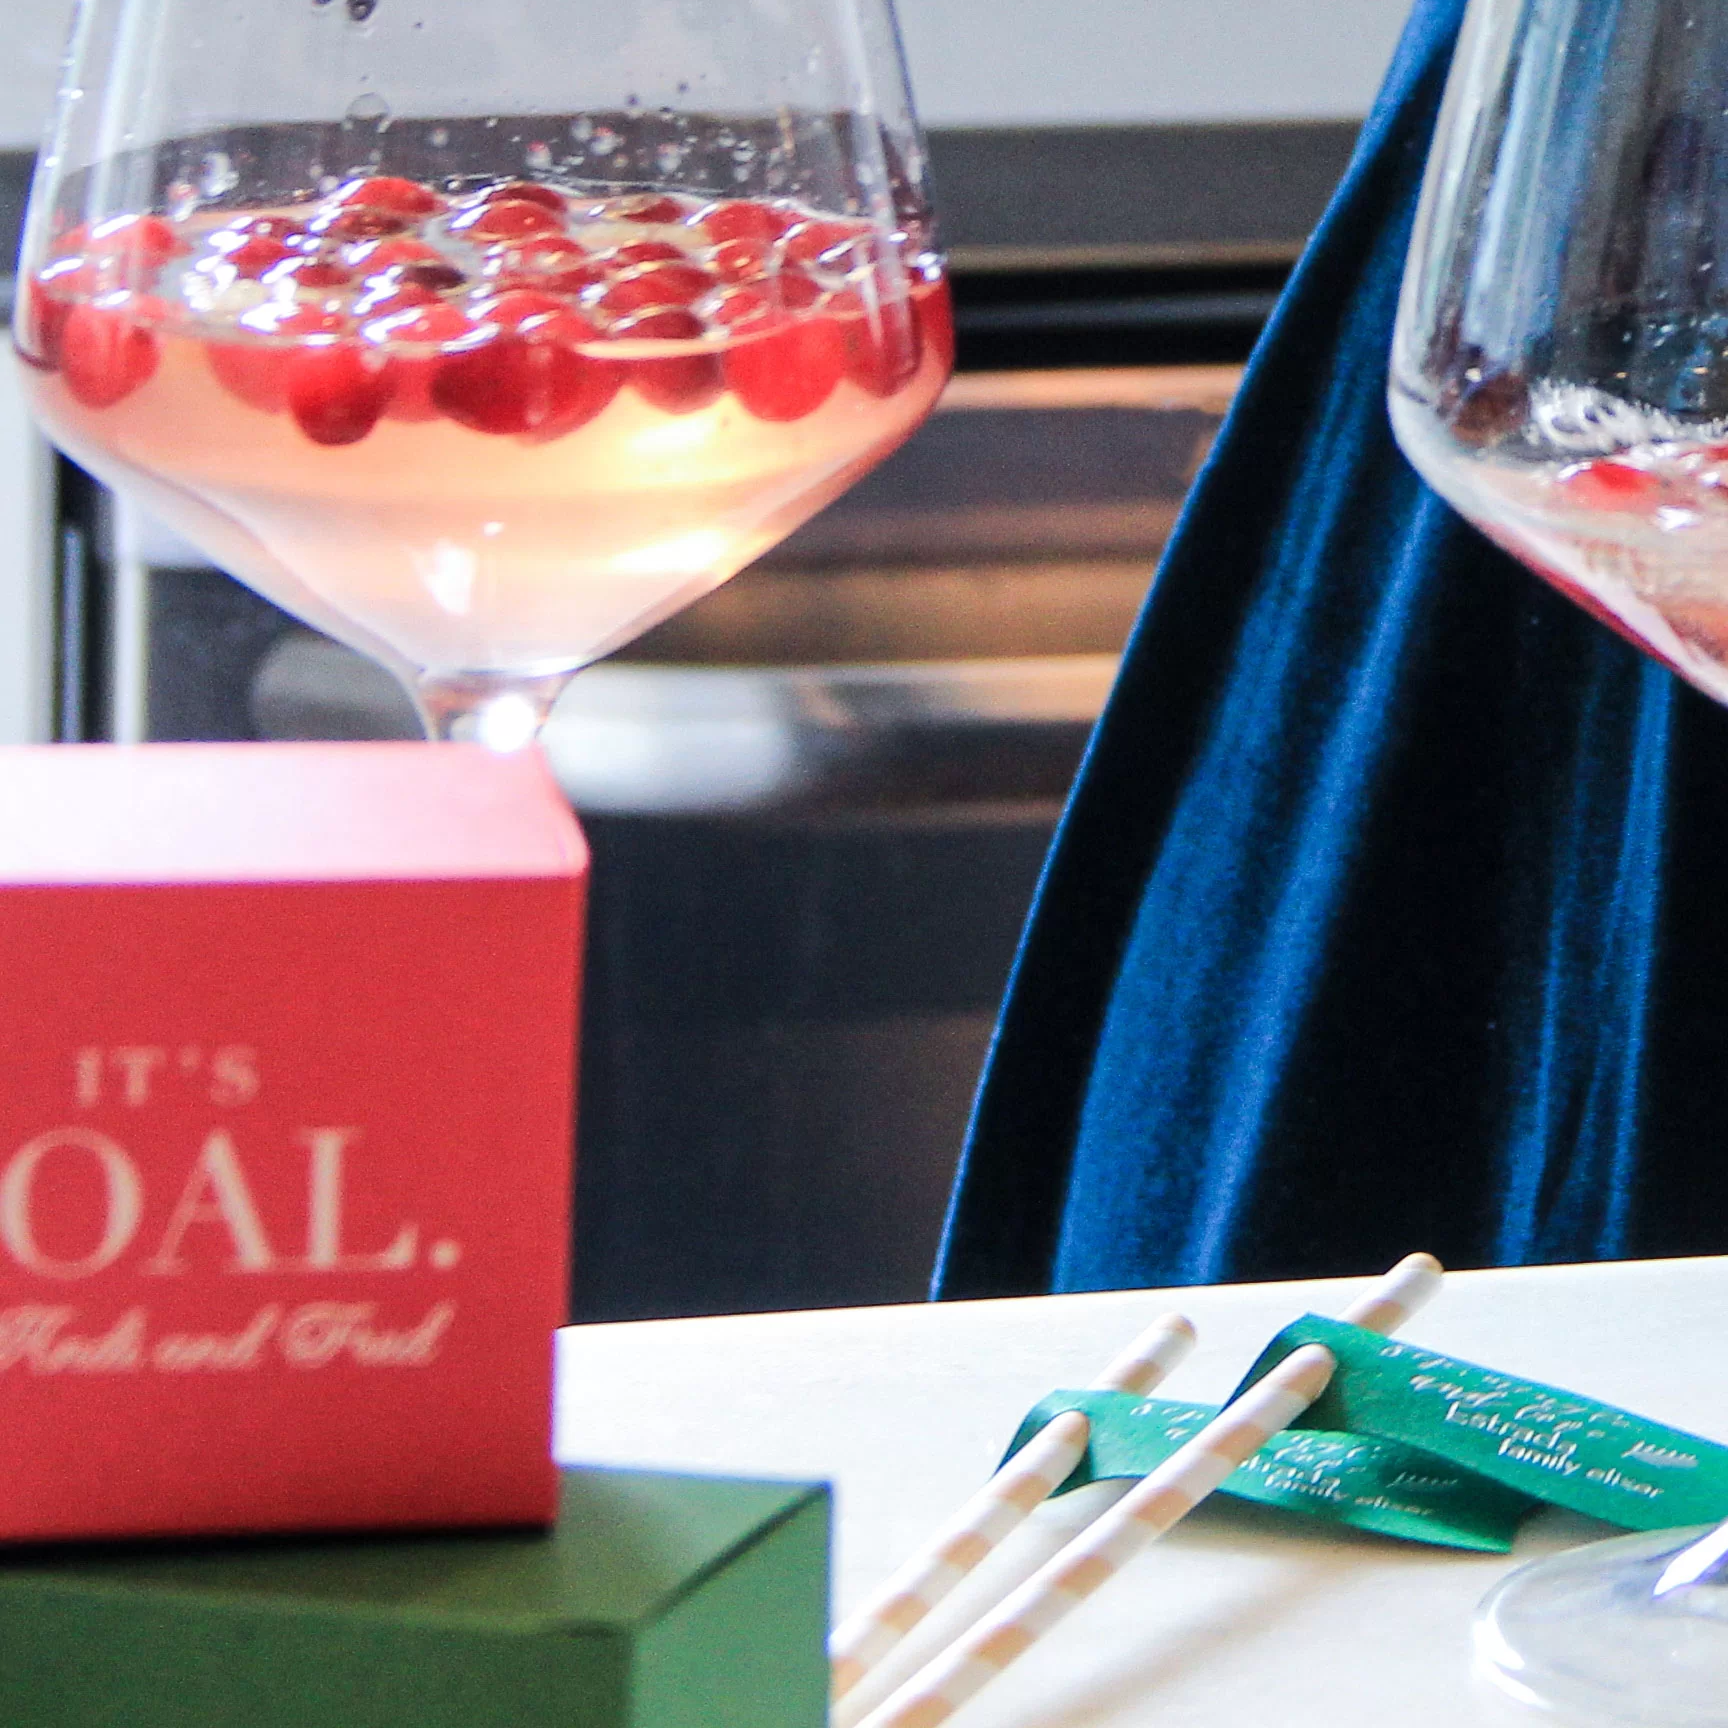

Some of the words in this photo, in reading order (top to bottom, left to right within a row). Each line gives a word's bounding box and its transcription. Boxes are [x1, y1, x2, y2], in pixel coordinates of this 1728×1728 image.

[77, 1045, 262, 1107] IT'S
[1445, 1400, 1579, 1456] Estrada
[1497, 1436, 1581, 1477] family
